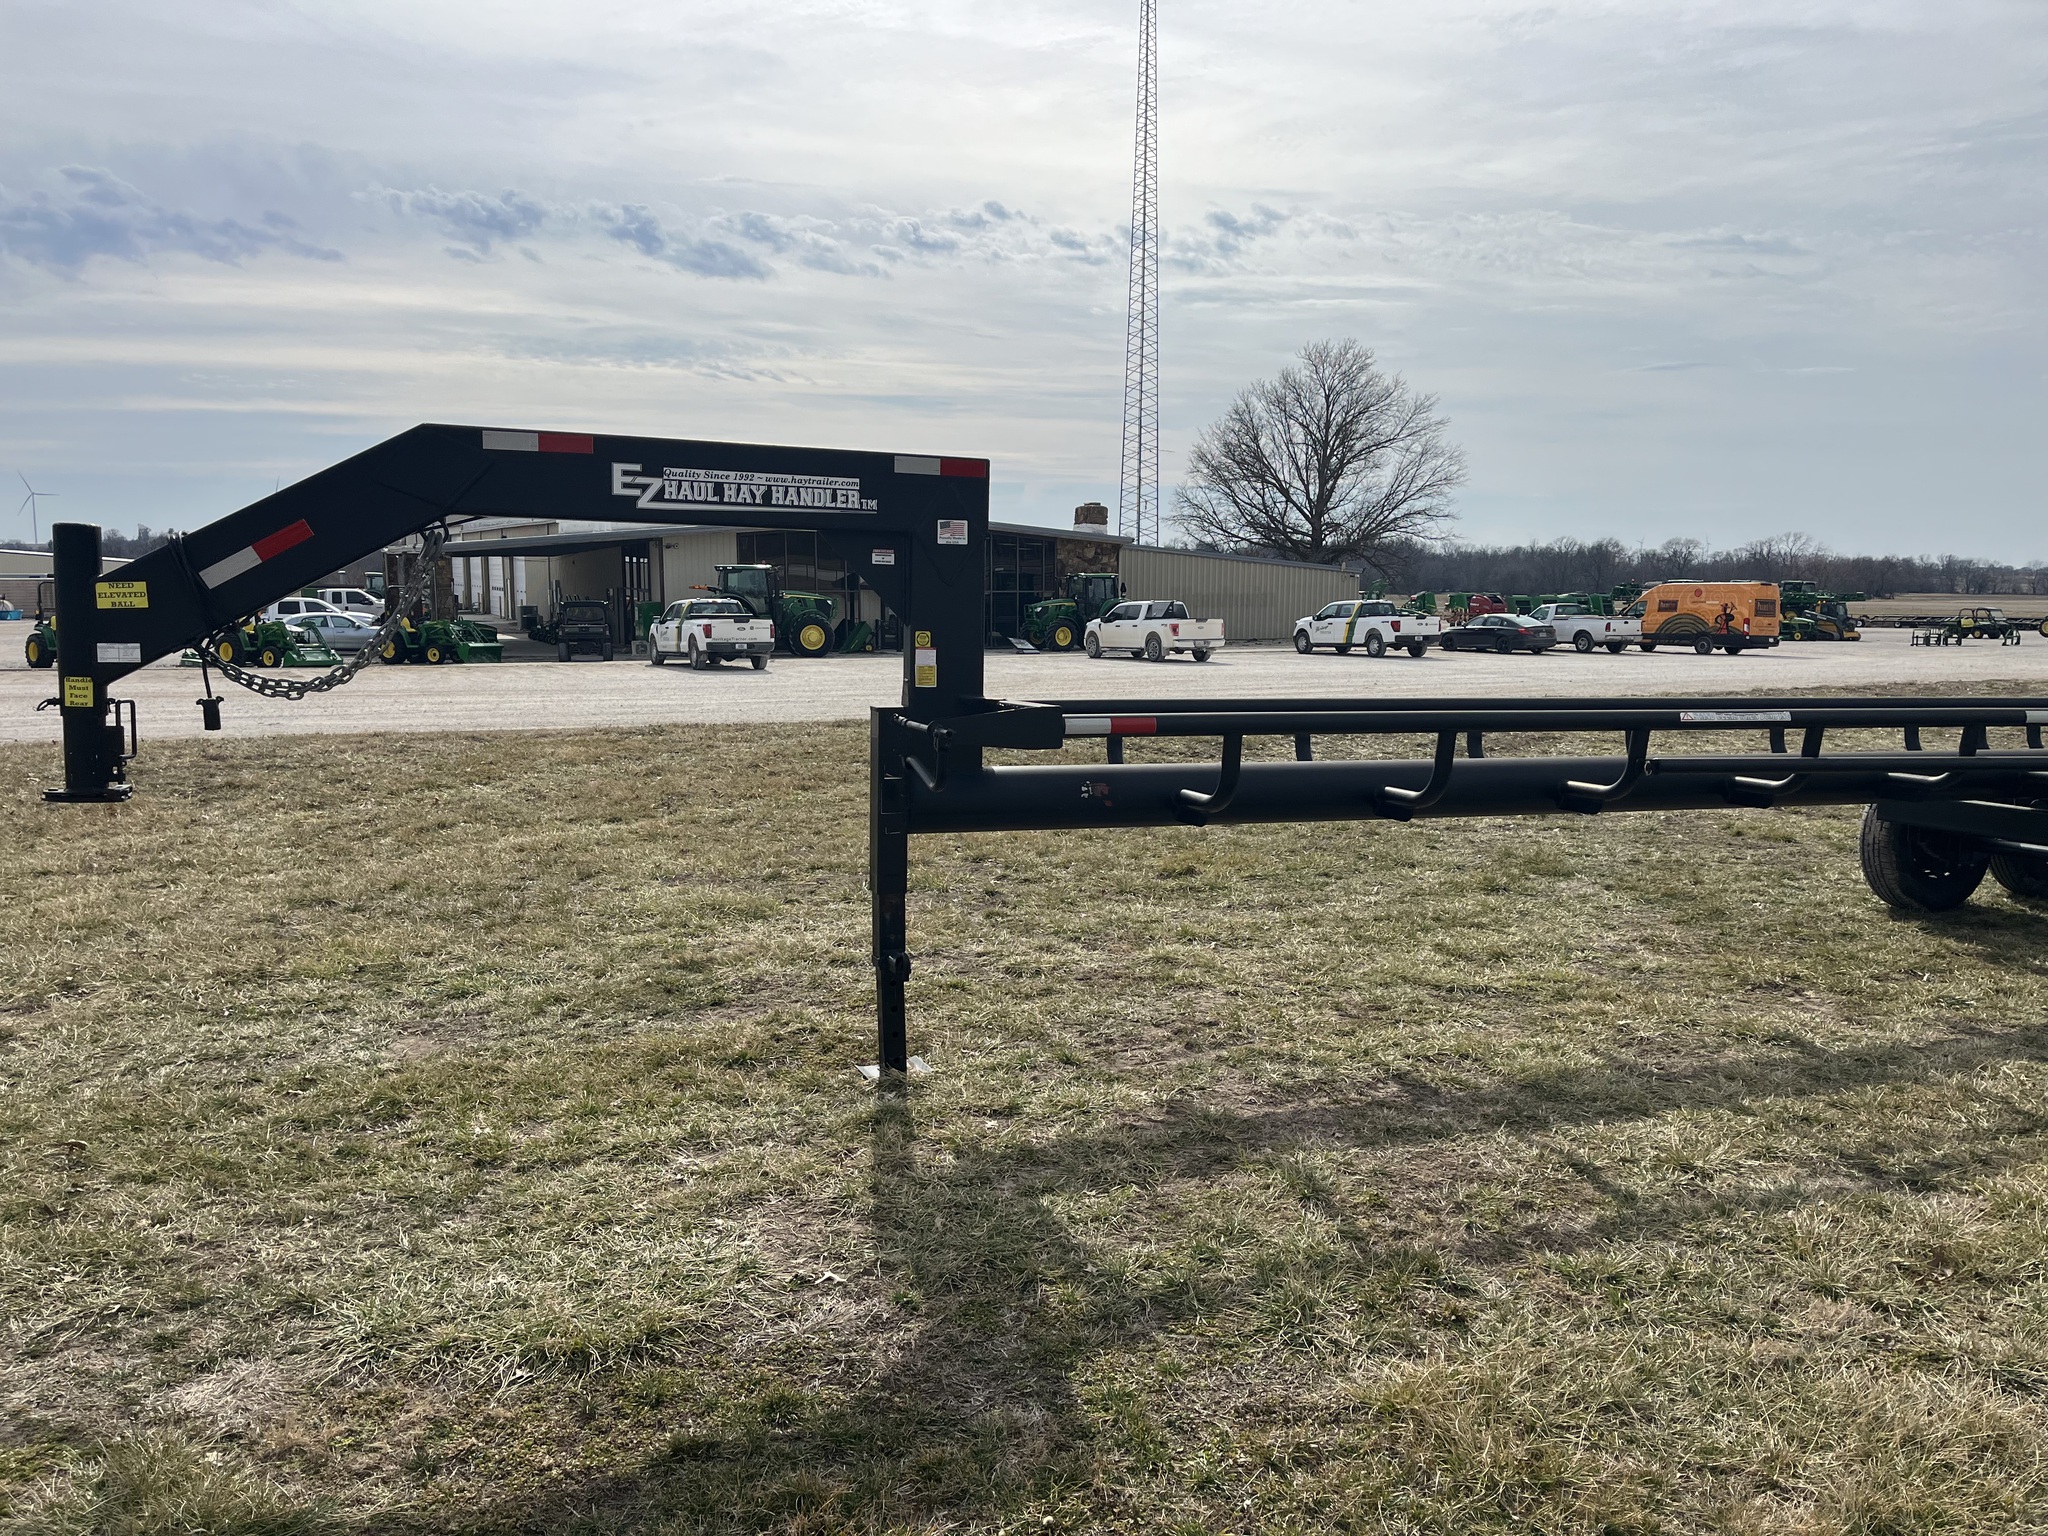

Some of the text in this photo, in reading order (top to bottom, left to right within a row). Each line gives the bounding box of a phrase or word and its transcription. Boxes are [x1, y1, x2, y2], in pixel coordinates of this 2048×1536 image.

[664, 469, 701, 479] Quality
[703, 471, 731, 481] Since
[733, 472, 755, 482] 1992
[765, 475, 859, 488] www.haytrailer.com
[664, 480, 878, 511] HAUL HAY HANDLER TM
[97, 591, 146, 599] ELEVATED
